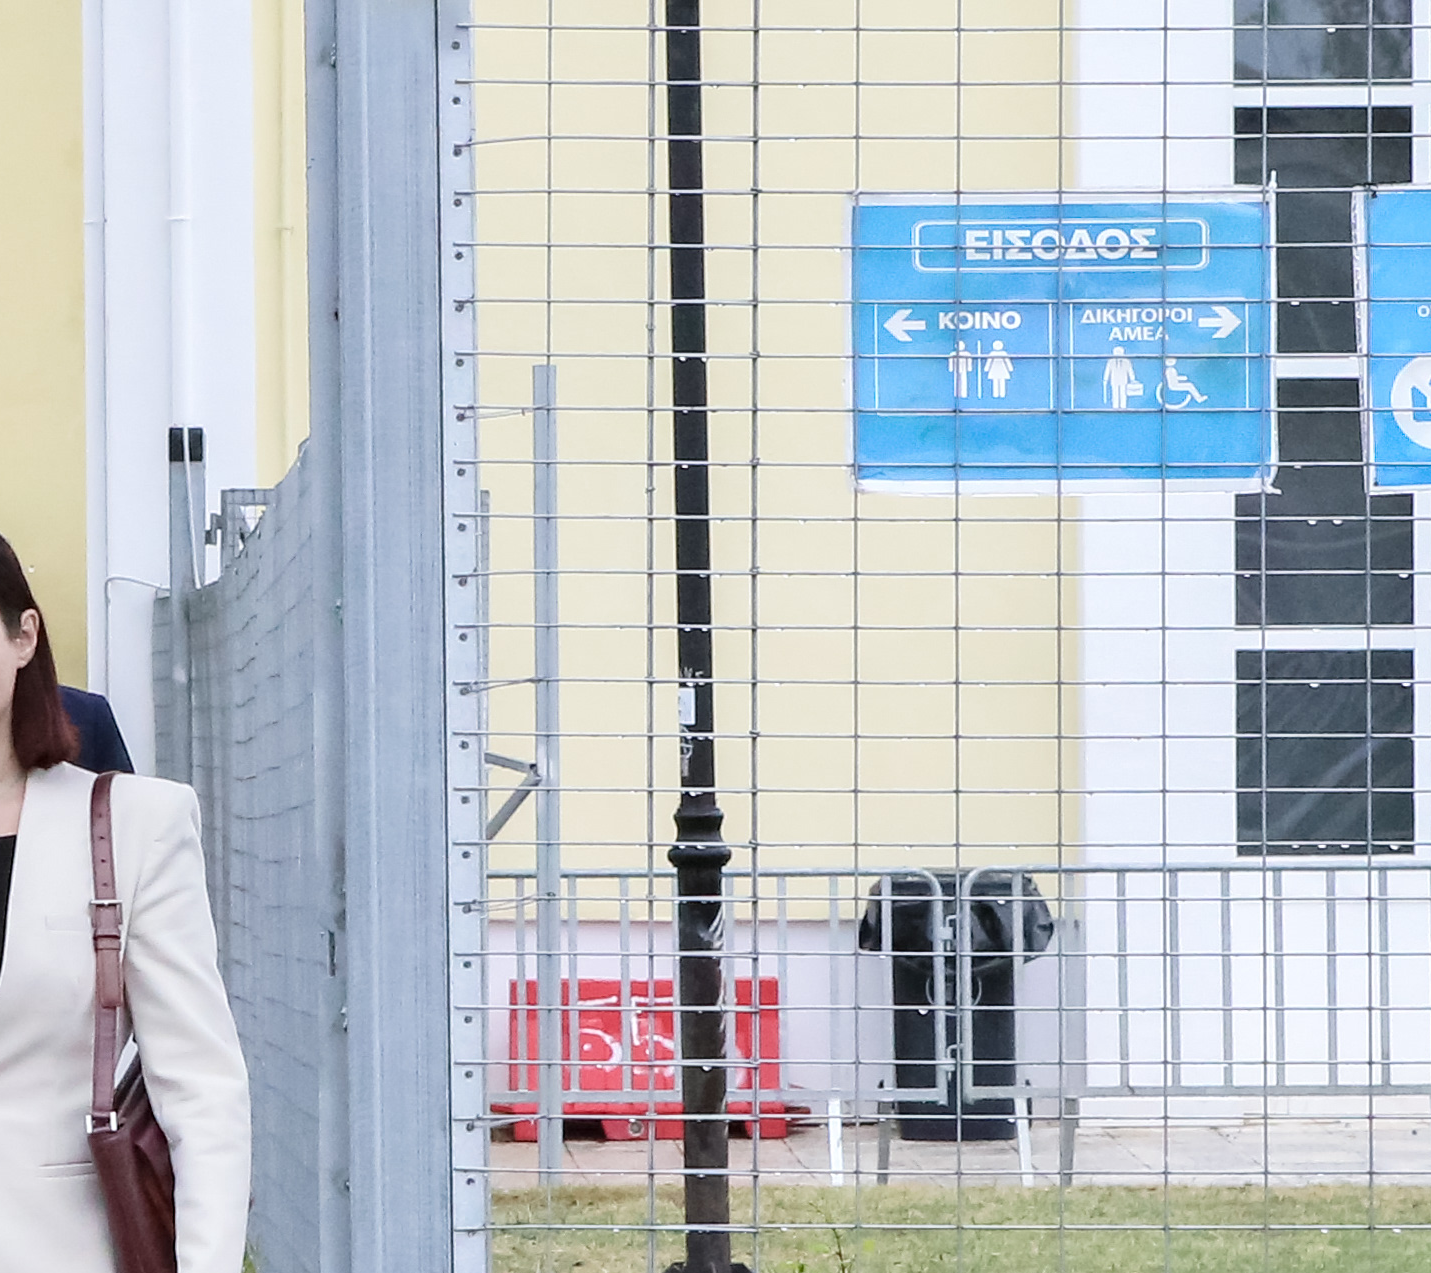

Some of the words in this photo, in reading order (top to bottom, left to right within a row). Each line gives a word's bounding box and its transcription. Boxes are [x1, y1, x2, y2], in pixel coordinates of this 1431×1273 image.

[965, 228, 1158, 261] ΕΙΣΟΔΟΣ
[938, 310, 1022, 331] ΚΟΙΝΟ
[1080, 307, 1193, 324] ΔΙΚΗΓΟΡΟΙ
[1108, 326, 1169, 341] ΑΜΕΑ
